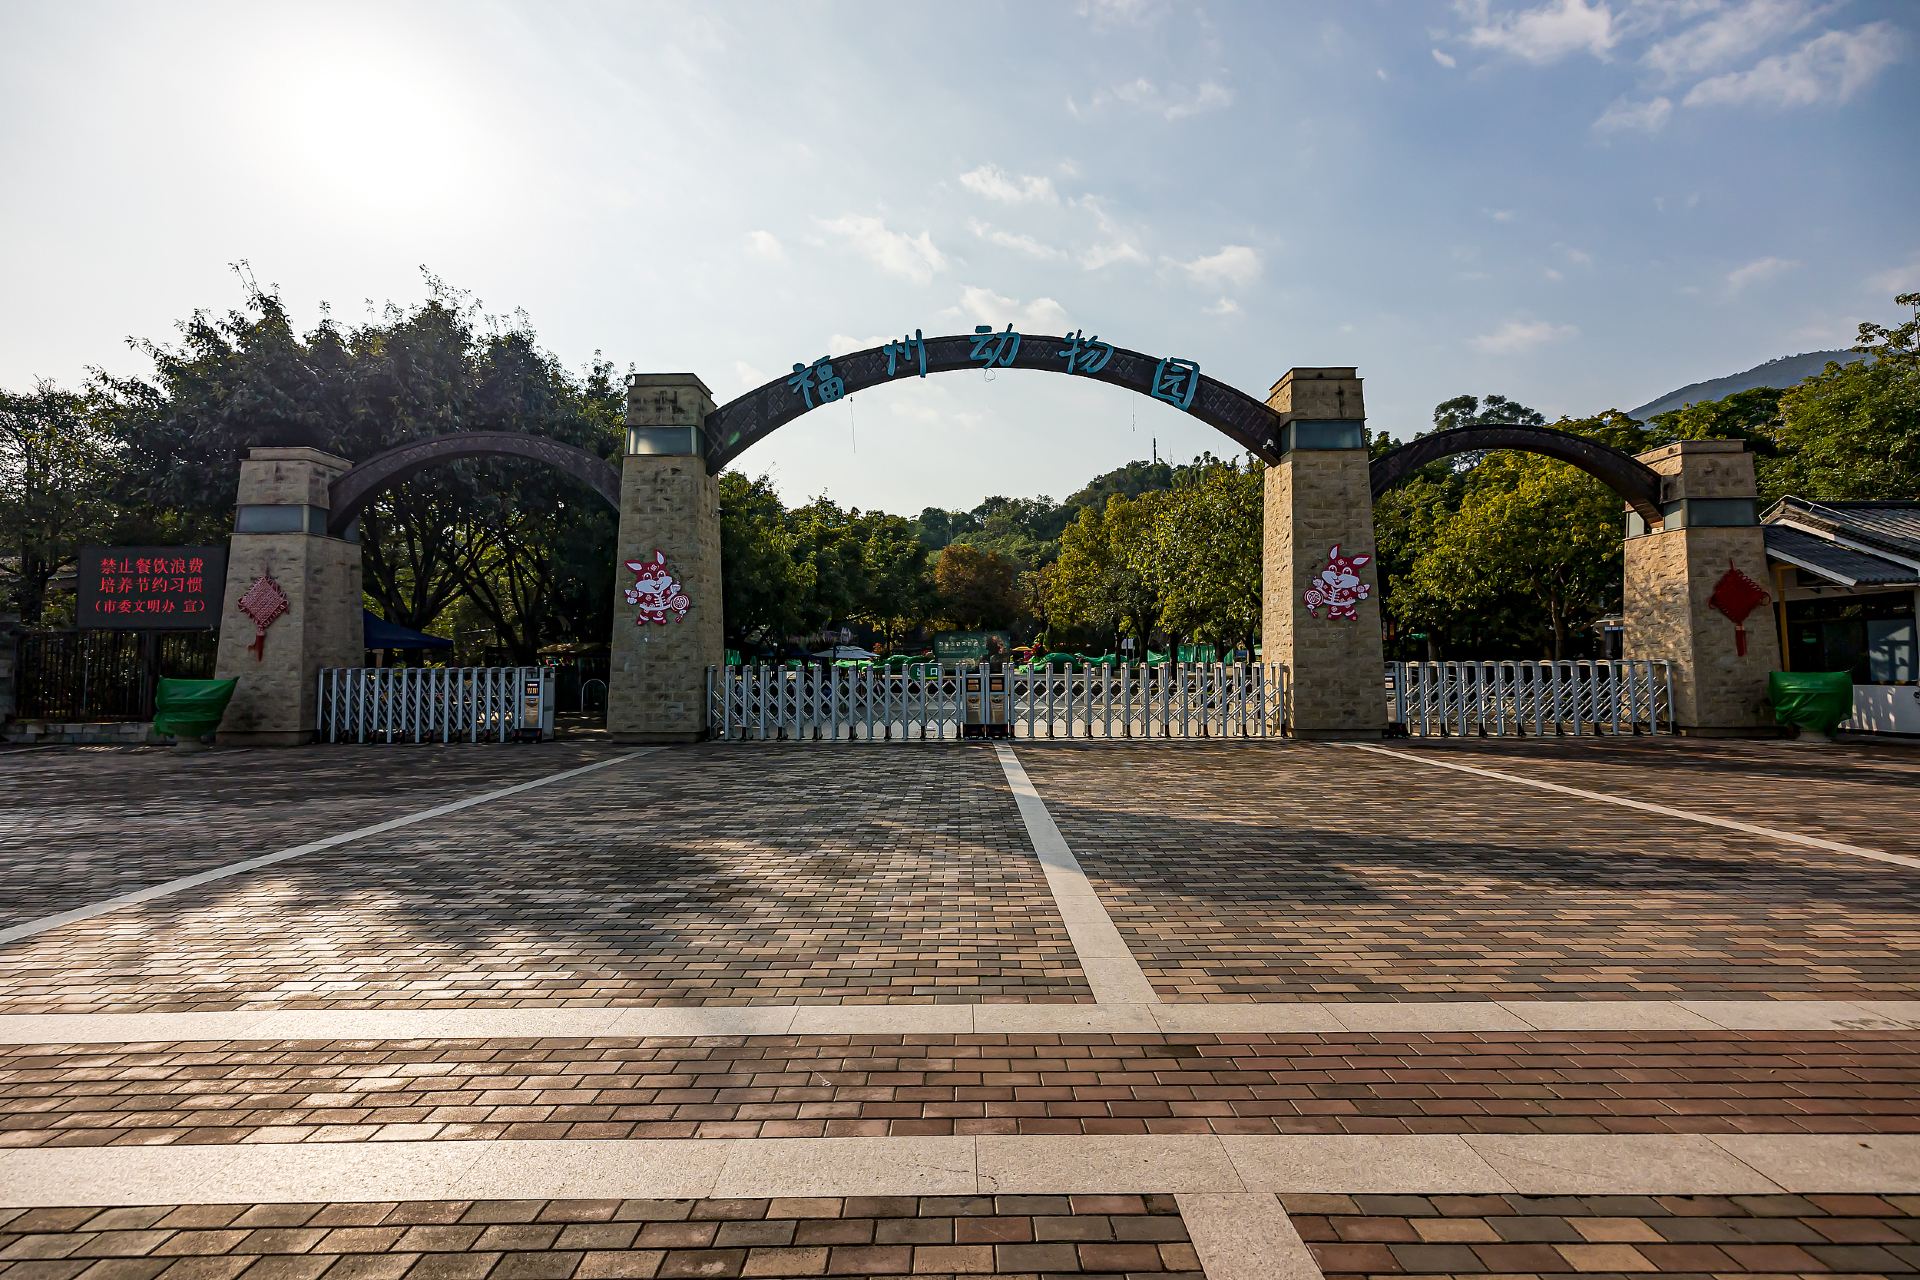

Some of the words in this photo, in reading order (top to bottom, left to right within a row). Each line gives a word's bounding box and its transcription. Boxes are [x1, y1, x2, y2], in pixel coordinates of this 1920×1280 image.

[788, 323, 1200, 411] 福州动物园
[100, 557, 204, 574] 禁止餐饮浪费
[99, 577, 203, 593] 培养节约习惯
